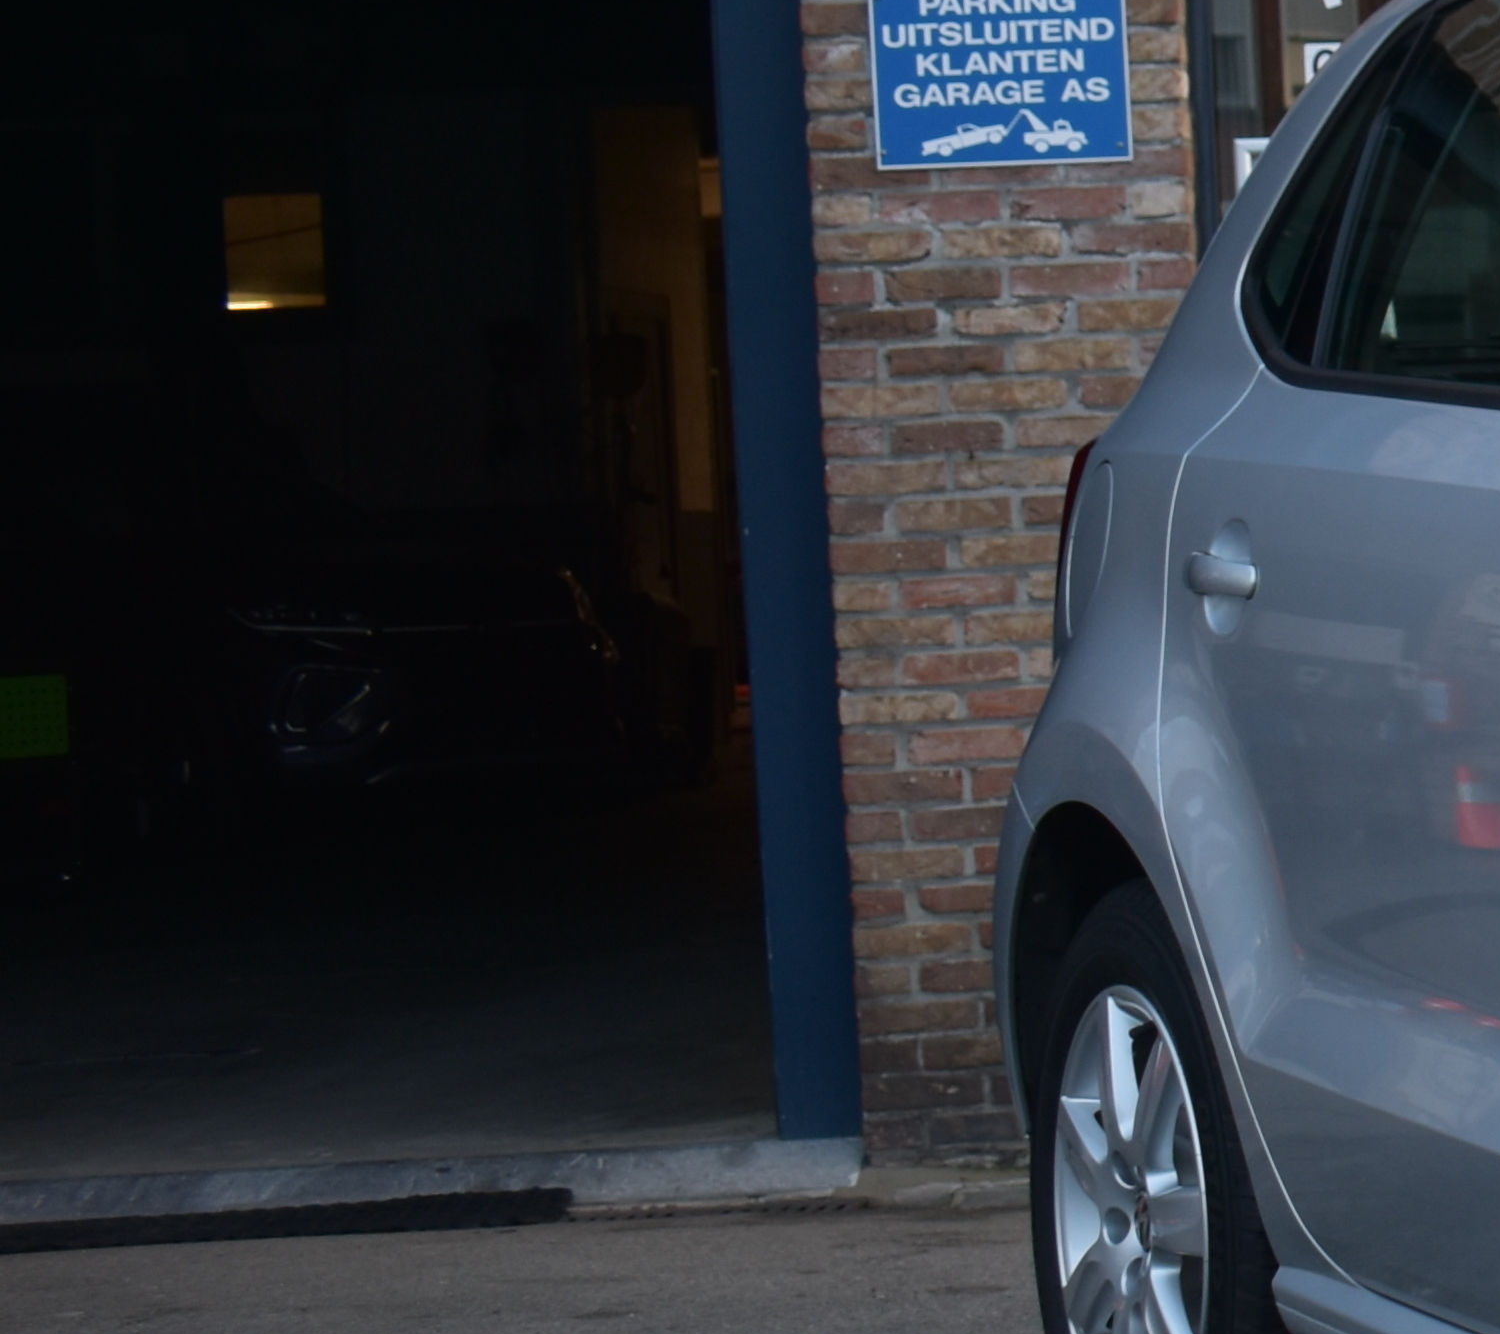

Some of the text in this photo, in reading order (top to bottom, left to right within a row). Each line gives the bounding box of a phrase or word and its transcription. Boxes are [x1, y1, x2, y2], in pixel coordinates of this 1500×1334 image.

[881, 17, 1116, 49] UITSLUITEND
[916, 48, 1086, 78] KLANTEN
[893, 77, 1111, 108] GARAGE AS
